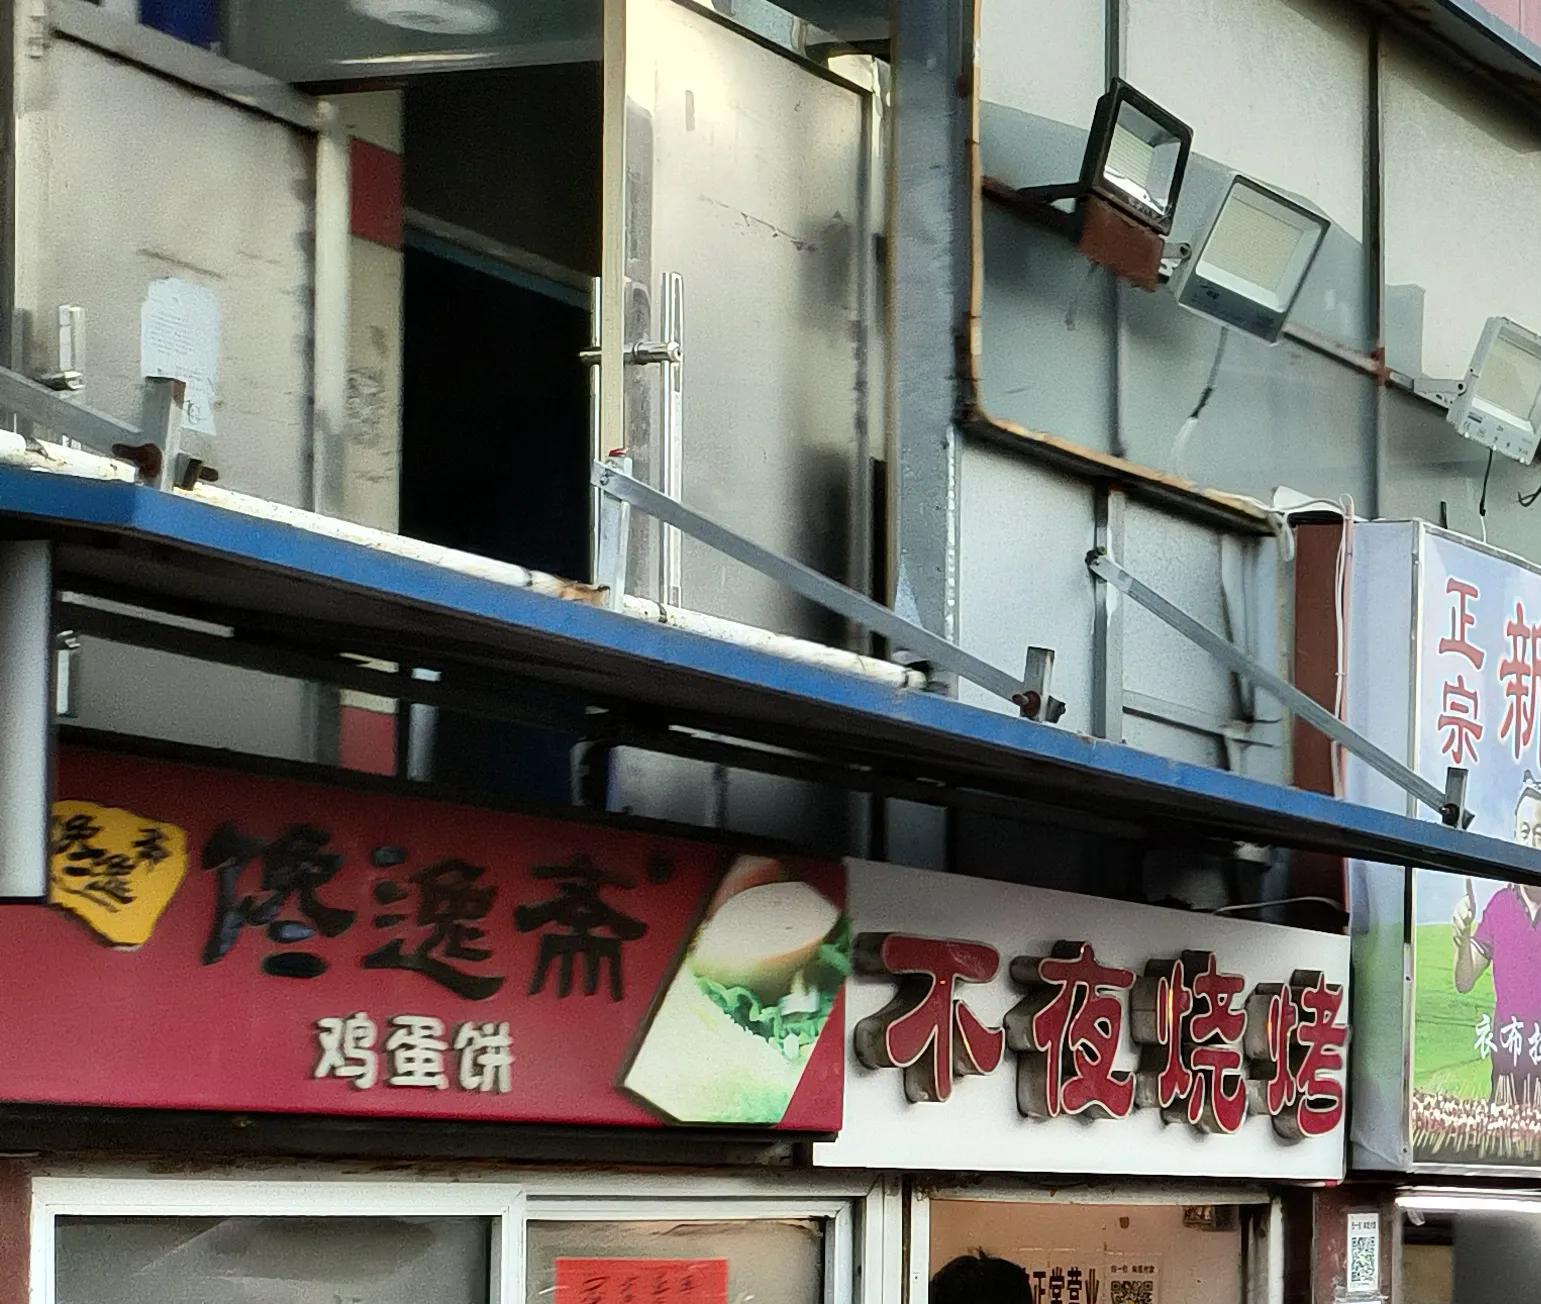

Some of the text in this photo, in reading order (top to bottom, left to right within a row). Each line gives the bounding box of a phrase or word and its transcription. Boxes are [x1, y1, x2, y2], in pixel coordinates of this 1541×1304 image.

[1439, 577, 1486, 765] 正宗
[313, 1012, 516, 1094] 鸡蛋饼
[872, 932, 1350, 1138] 不夜烧烤
